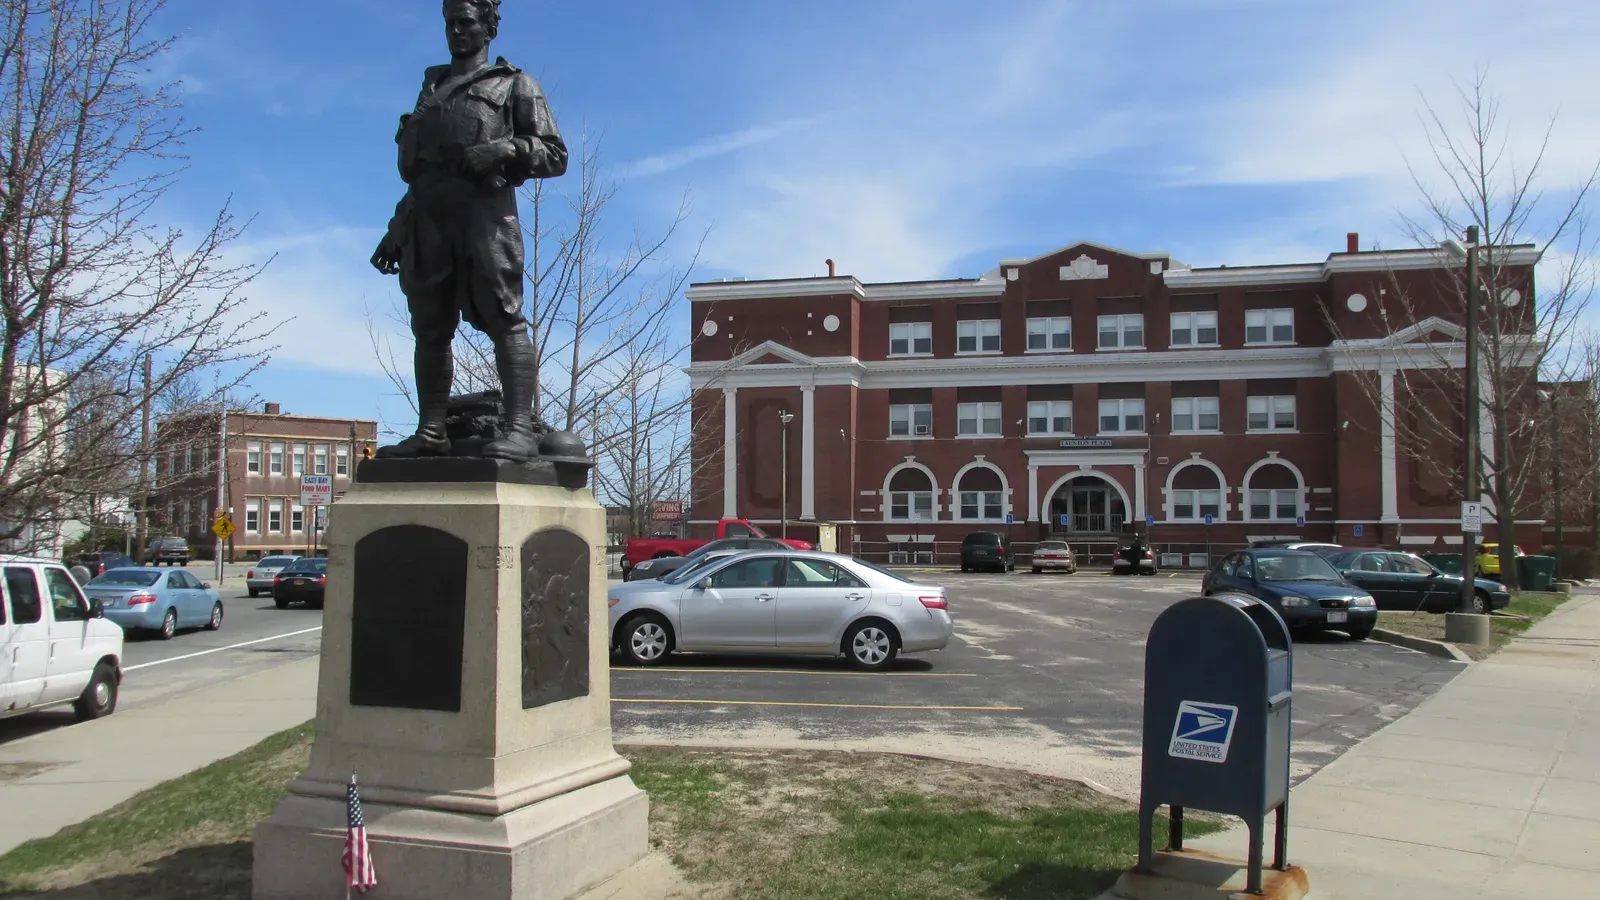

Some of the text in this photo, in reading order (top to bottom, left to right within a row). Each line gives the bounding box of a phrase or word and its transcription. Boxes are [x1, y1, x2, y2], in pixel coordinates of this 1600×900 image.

[1173, 741, 1221, 752] UNITED STATES
[1172, 748, 1222, 759] POSTAL SERVICE
